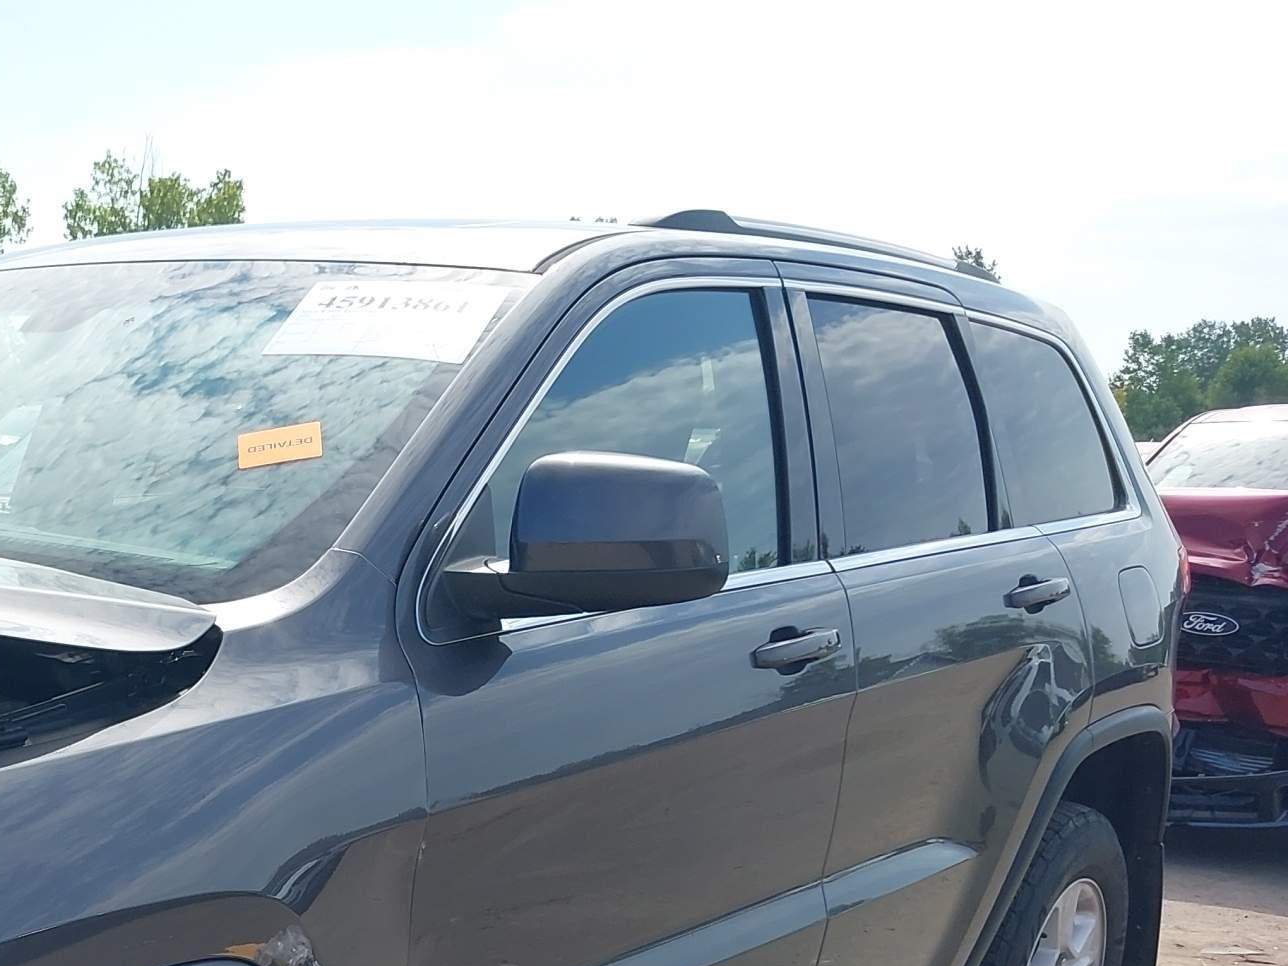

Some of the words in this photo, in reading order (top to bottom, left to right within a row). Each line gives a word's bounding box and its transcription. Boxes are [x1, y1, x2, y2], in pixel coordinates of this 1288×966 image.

[317, 295, 469, 313] 45913861
[247, 437, 313, 453] DETAILED
[1183, 614, 1227, 633] Ford
